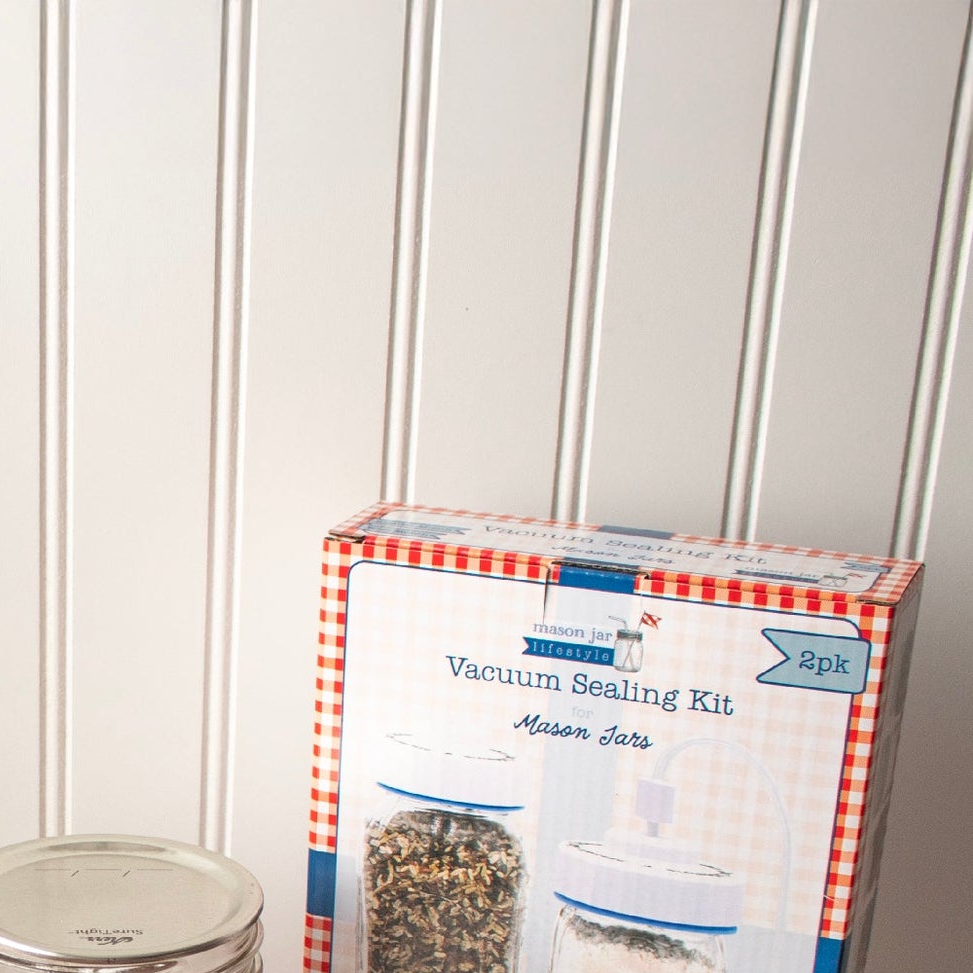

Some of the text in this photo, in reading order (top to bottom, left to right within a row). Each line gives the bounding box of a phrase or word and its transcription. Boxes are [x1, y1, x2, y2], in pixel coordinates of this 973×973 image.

[484, 525, 595, 544] Vacuum
[605, 539, 715, 559] Sealing
[724, 553, 767, 565] Kit
[533, 621, 613, 644] mason jar
[533, 641, 609, 662] lifestyle
[799, 650, 850, 676] 2pk
[446, 655, 734, 716] Vacuum Sealing Kit
[571, 705, 594, 719] for
[513, 713, 653, 750] Mason Jars
